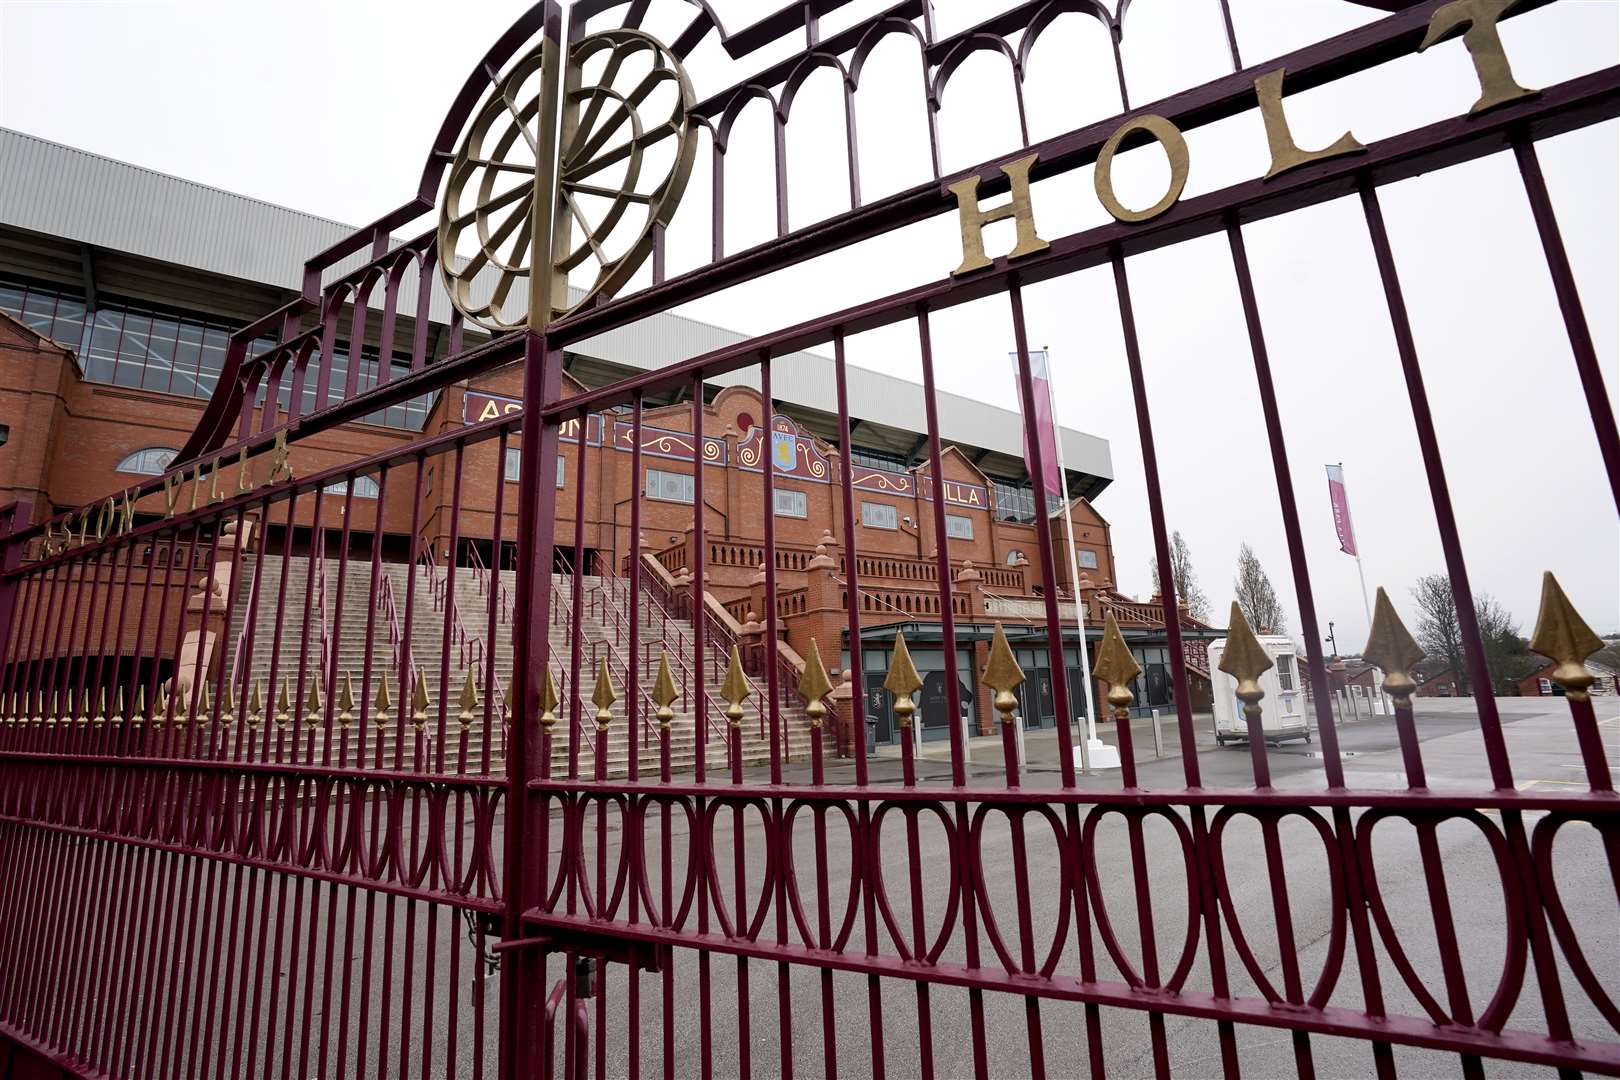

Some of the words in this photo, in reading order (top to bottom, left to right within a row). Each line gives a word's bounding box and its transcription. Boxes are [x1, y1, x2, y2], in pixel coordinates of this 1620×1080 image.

[948, 0, 1542, 276] HOLT
[40, 486, 141, 562] ASTON
[164, 428, 293, 520] VILLA
[931, 481, 980, 505] ILLA
